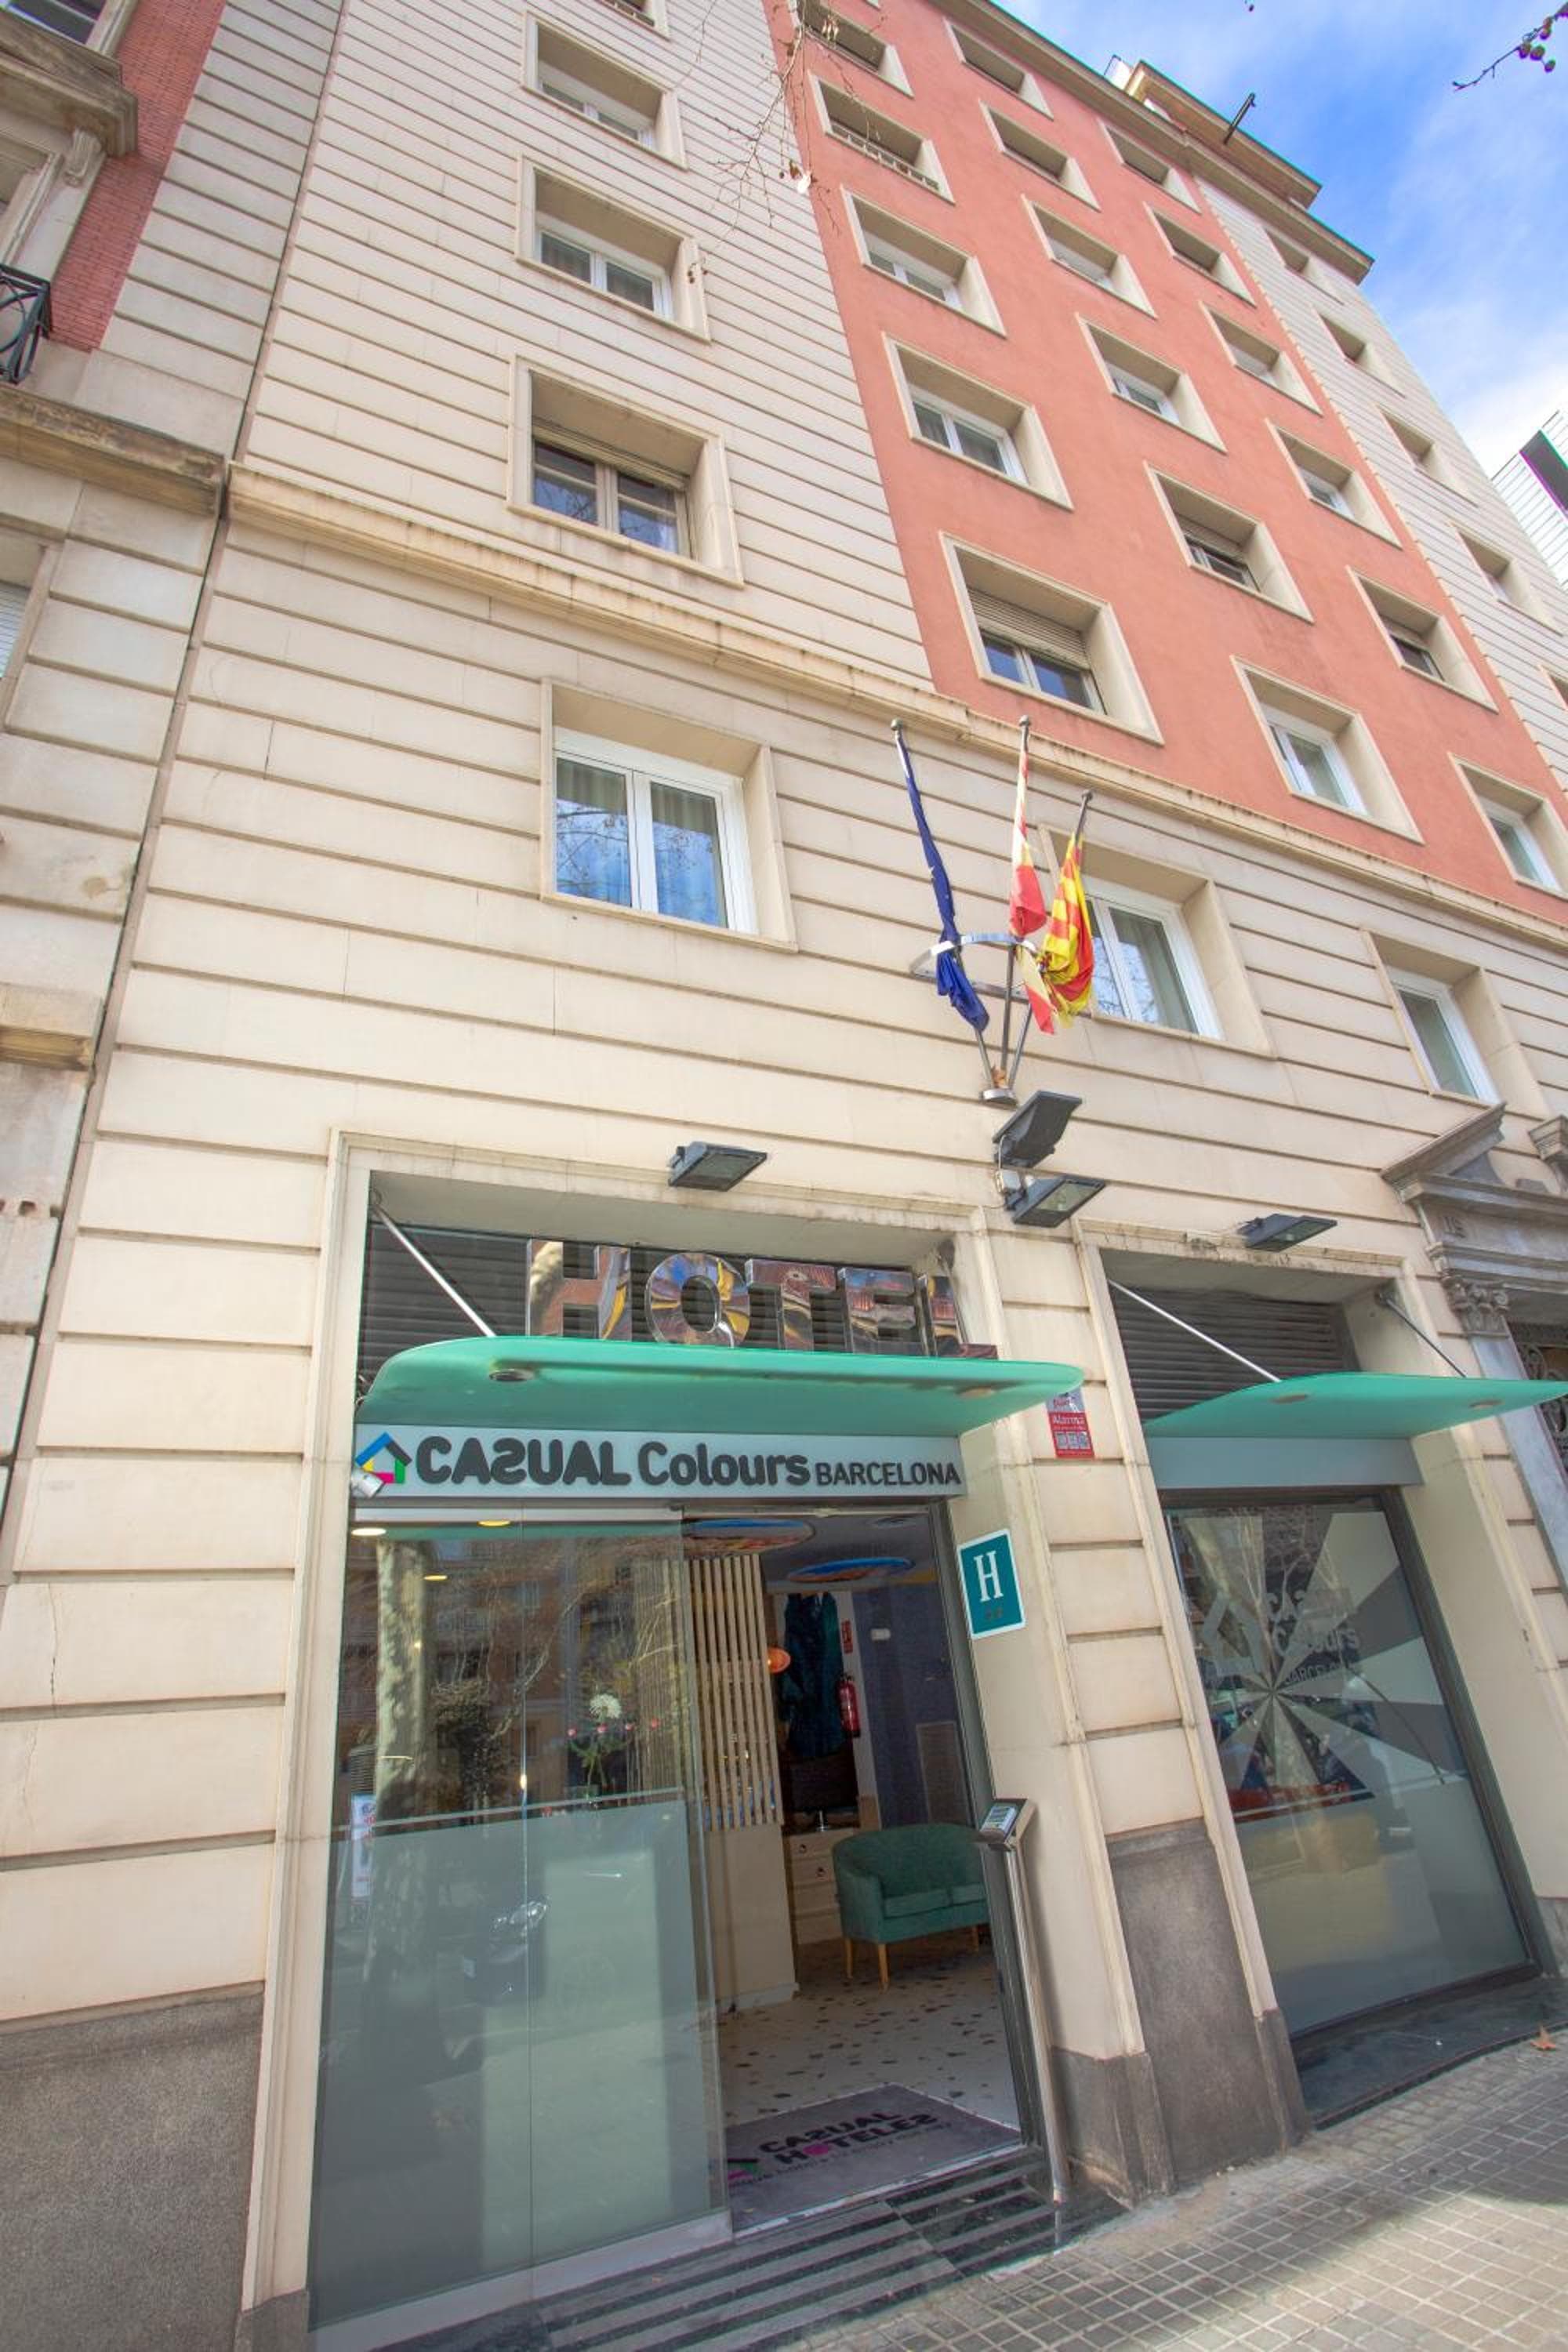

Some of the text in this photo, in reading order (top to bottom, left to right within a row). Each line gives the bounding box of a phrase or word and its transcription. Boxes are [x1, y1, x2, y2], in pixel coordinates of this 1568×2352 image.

[524, 1237, 999, 1359] HOTEL
[416, 1435, 963, 1487] CASUAL Colours BARCELONA
[973, 1550, 1004, 1603] H
